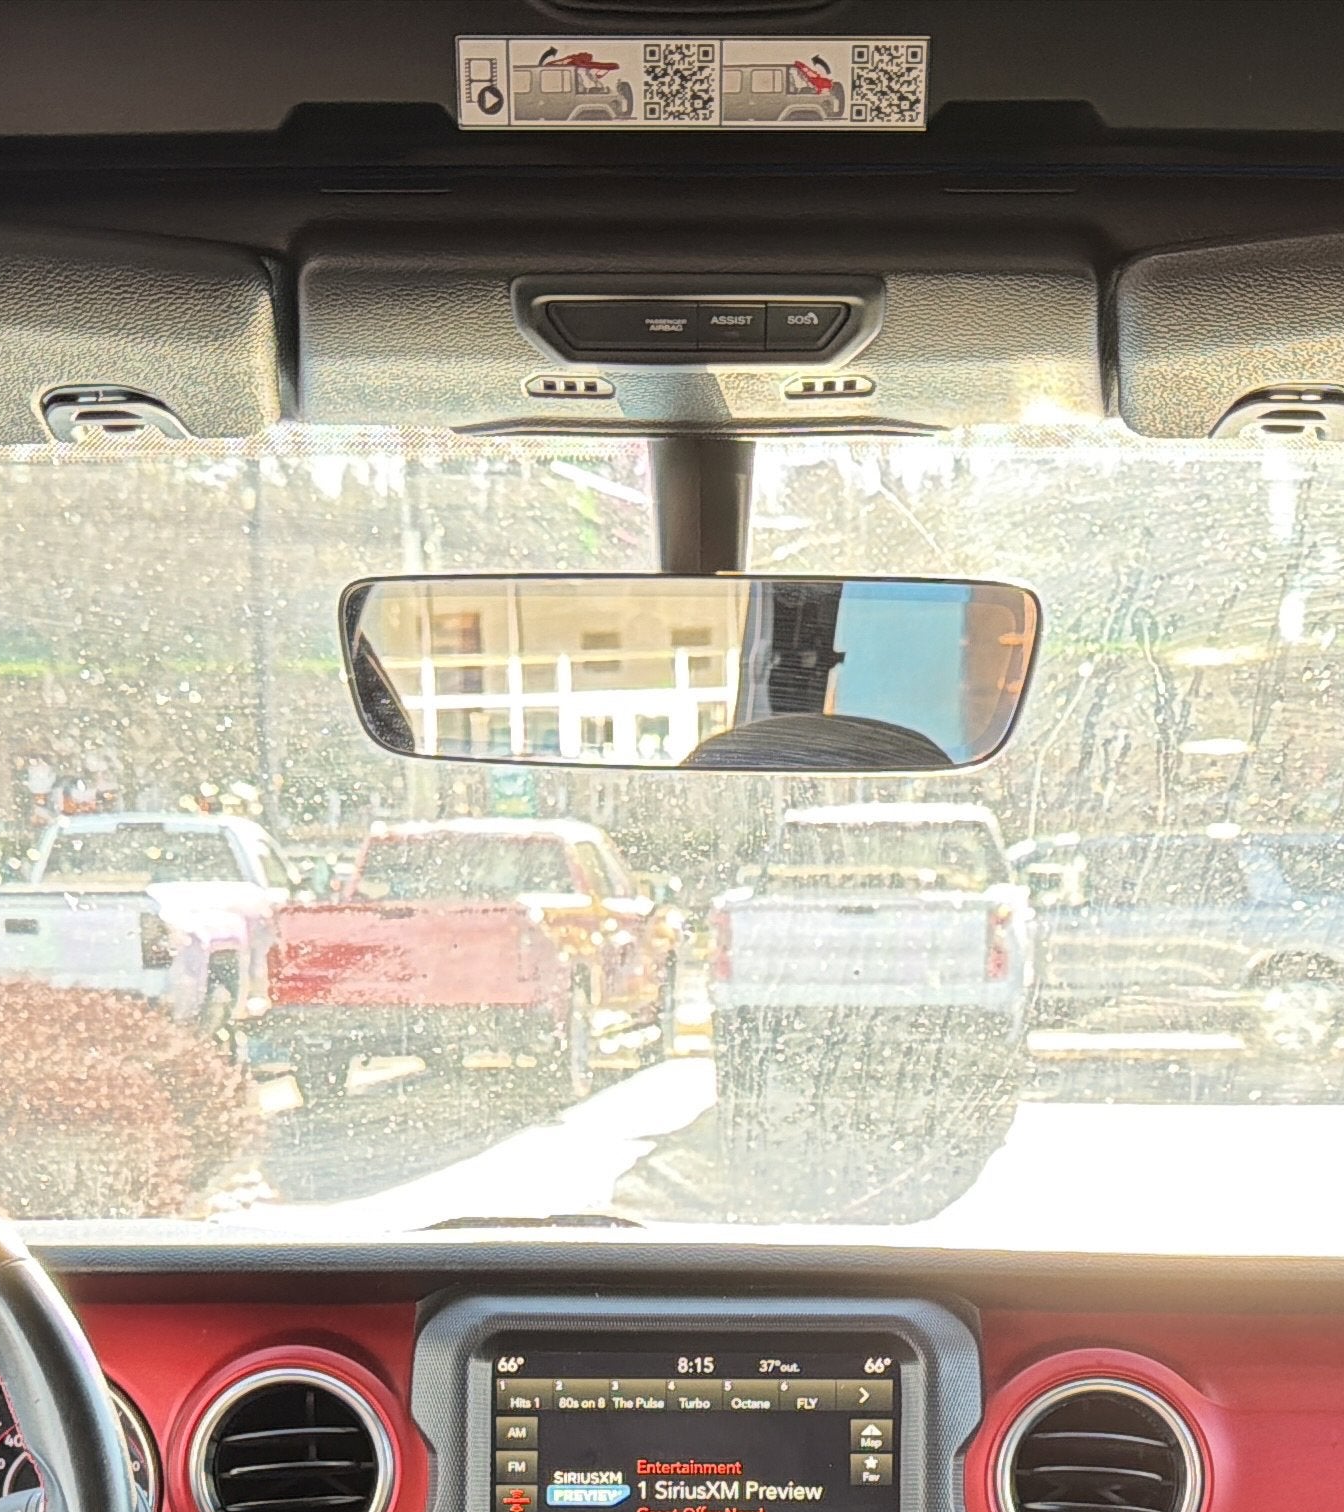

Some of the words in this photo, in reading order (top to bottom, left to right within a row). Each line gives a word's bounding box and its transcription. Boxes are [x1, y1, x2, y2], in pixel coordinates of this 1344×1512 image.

[710, 316, 753, 325] ASSIST
[787, 315, 812, 325] SOS
[649, 324, 683, 332] AIRBAG
[677, 1357, 715, 1374] 8:15
[499, 1381, 506, 1391] 1
[555, 1381, 563, 1391] 2
[611, 1382, 619, 1391] 3
[668, 1381, 676, 1391] 4
[724, 1381, 732, 1391] 5
[780, 1381, 788, 1391] 6
[510, 1397, 531, 1409] Hits
[534, 1397, 541, 1409] 1
[559, 1397, 579, 1409] 80s
[581, 1400, 596, 1409] on
[597, 1397, 606, 1409] 8
[613, 1397, 634, 1409] The
[636, 1397, 665, 1409] Pulse
[679, 1397, 711, 1410] Turbo
[731, 1397, 771, 1410] Octane
[796, 1398, 818, 1410] FLY
[507, 1427, 527, 1439] AM
[861, 1438, 883, 1449] Map
[508, 1461, 526, 1473] FM
[636, 1460, 742, 1474] Entertainment
[553, 1471, 623, 1484] SIRIUSXM
[863, 1472, 881, 1482] Fav
[553, 1489, 622, 1502] PREVIEW
[638, 1481, 647, 1500] 1
[654, 1481, 739, 1500] SiriusXM
[746, 1481, 823, 1500] Preview
